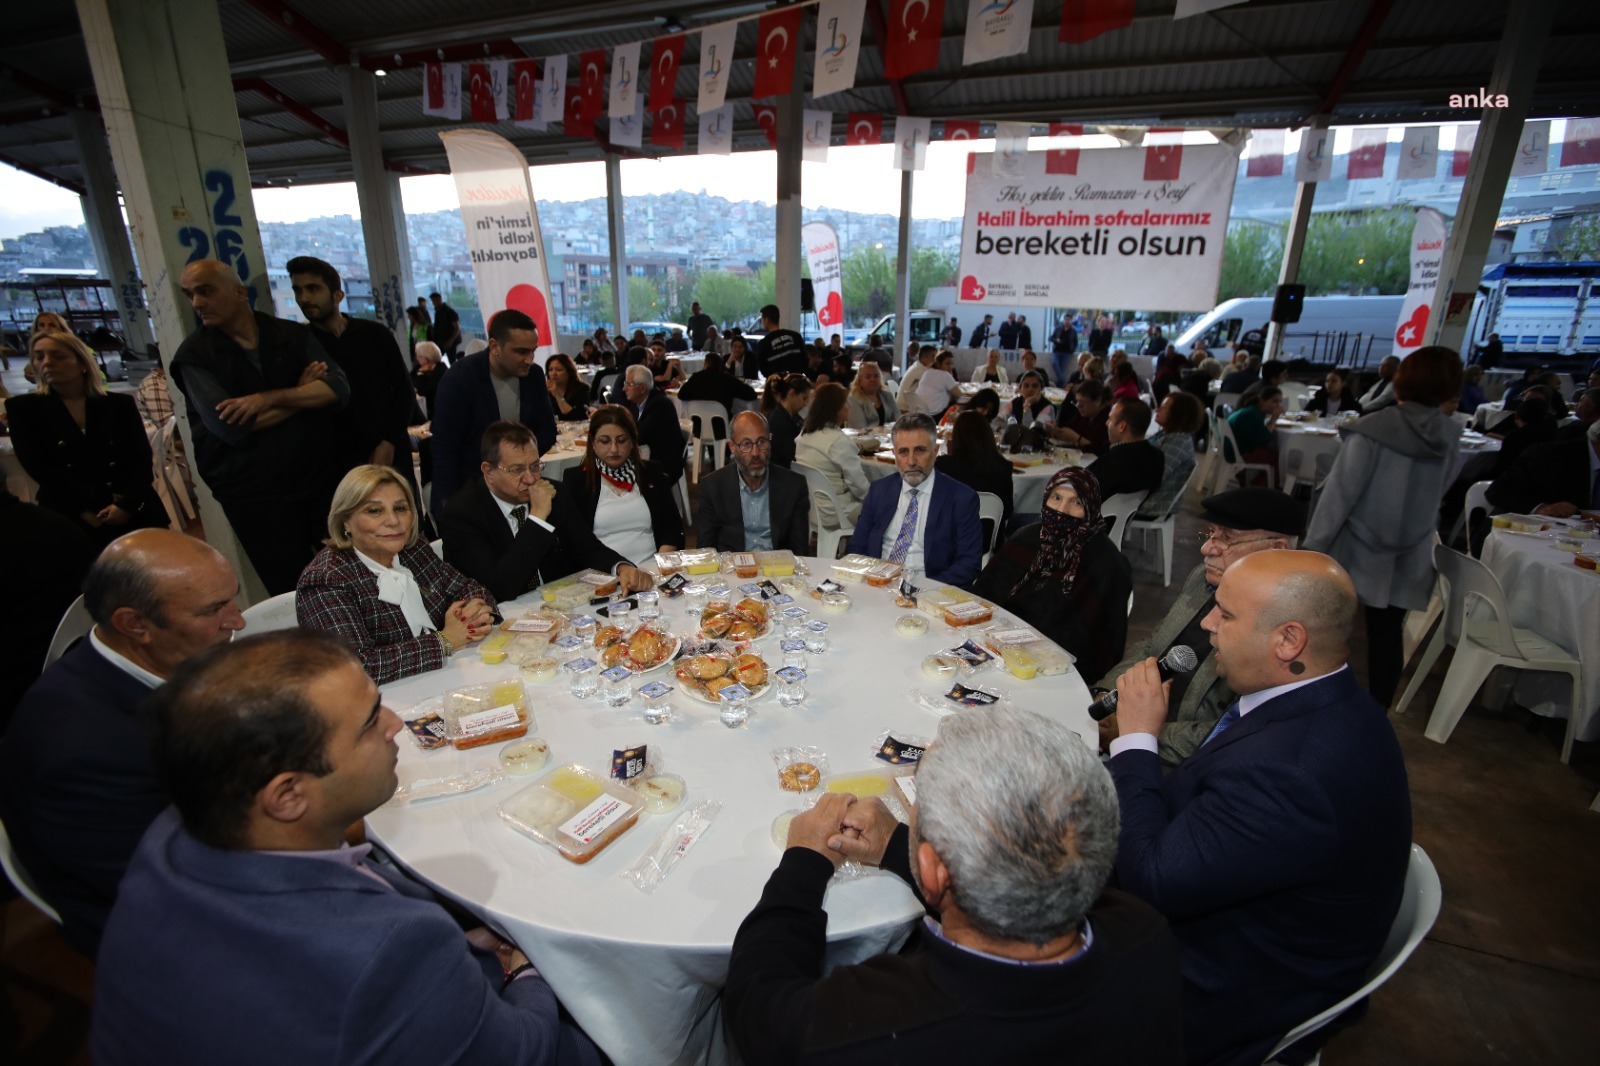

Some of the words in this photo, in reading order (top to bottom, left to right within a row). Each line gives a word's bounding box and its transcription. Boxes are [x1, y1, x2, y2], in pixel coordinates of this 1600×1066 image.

[1027, 185, 1065, 206] geldin
[977, 211, 1015, 227] Halil
[1019, 207, 1090, 227] İbrahim
[1094, 209, 1212, 227] sofralarımız
[975, 229, 1110, 256] bereketli
[1118, 227, 1206, 256] olsun
